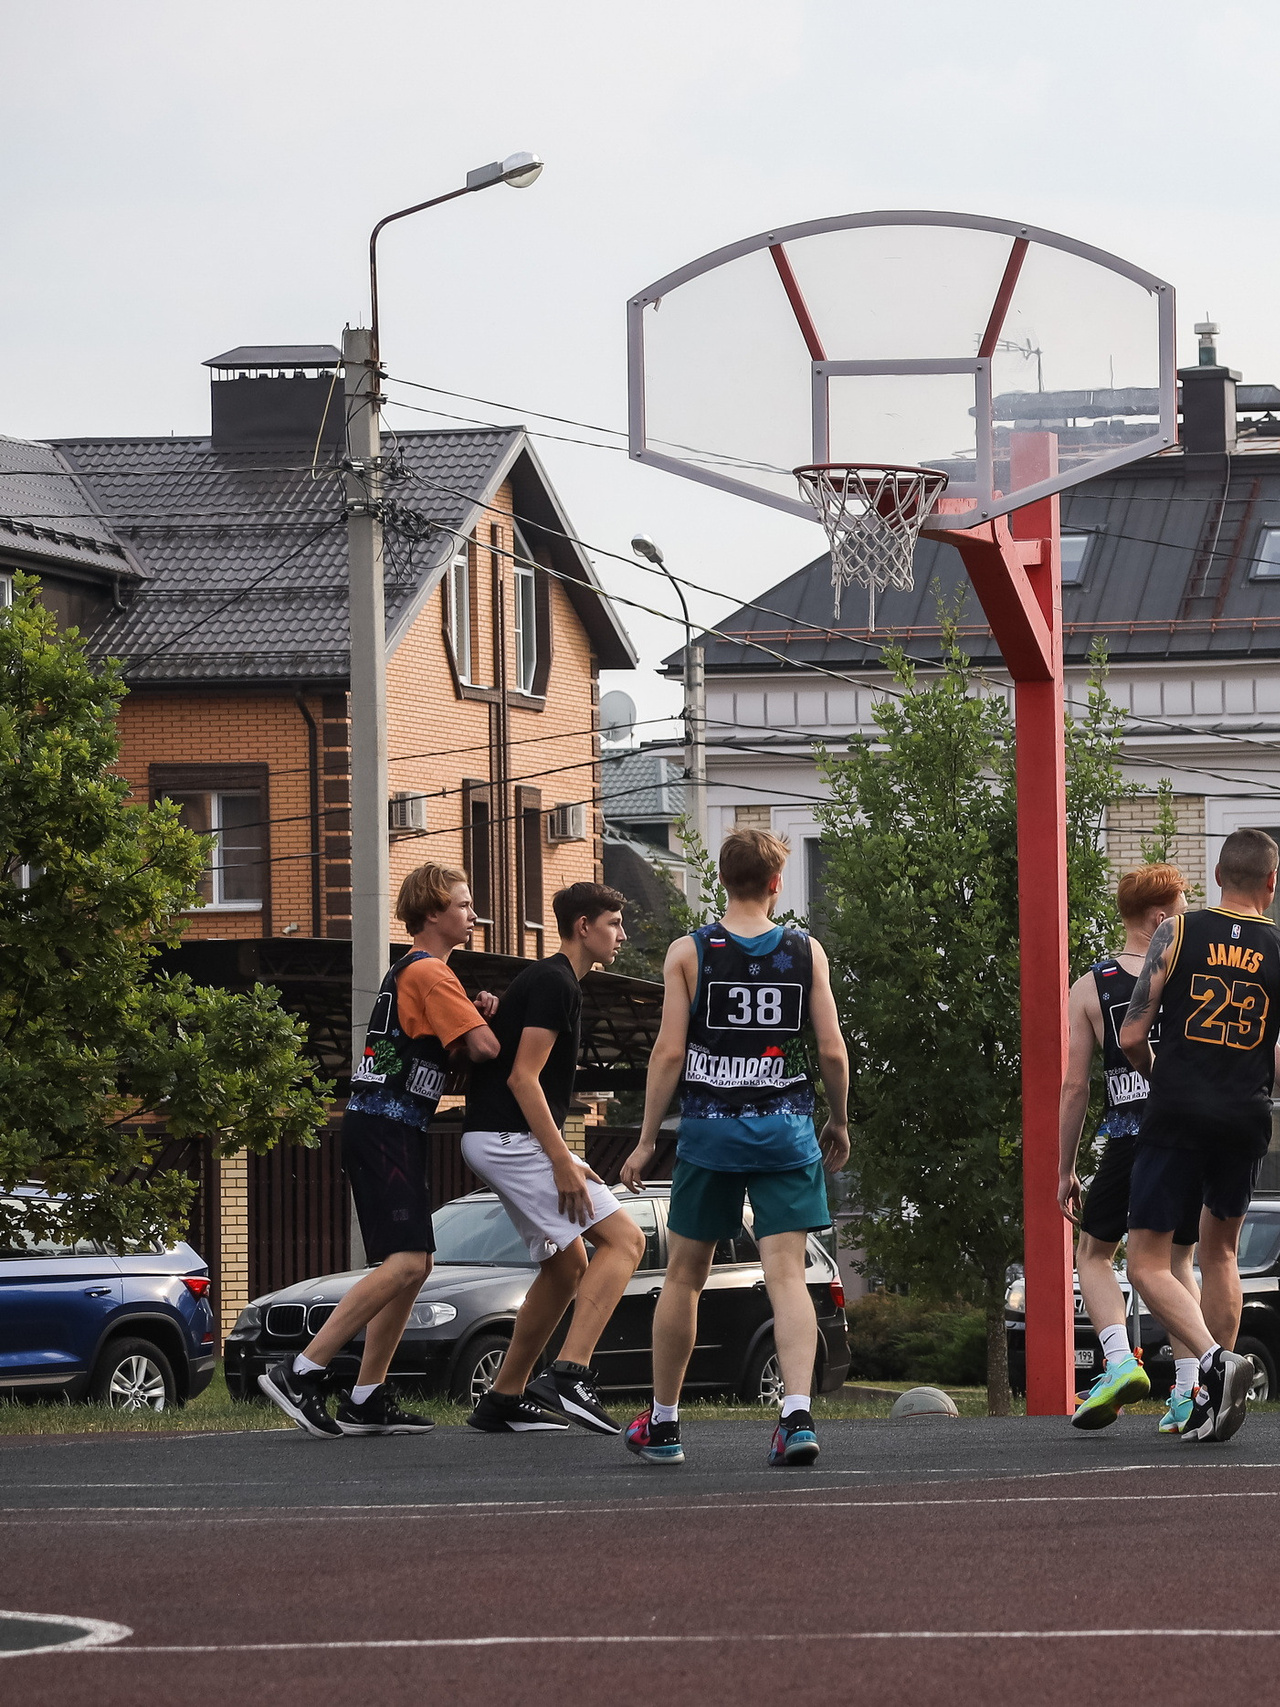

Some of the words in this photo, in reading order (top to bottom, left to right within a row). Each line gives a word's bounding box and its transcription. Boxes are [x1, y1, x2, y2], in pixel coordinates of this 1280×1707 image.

[1207, 943, 1264, 974] JAMES
[728, 987, 782, 1025] 38
[1184, 973, 1270, 1051] 23
[687, 1050, 785, 1080] ПОТАПОВО
